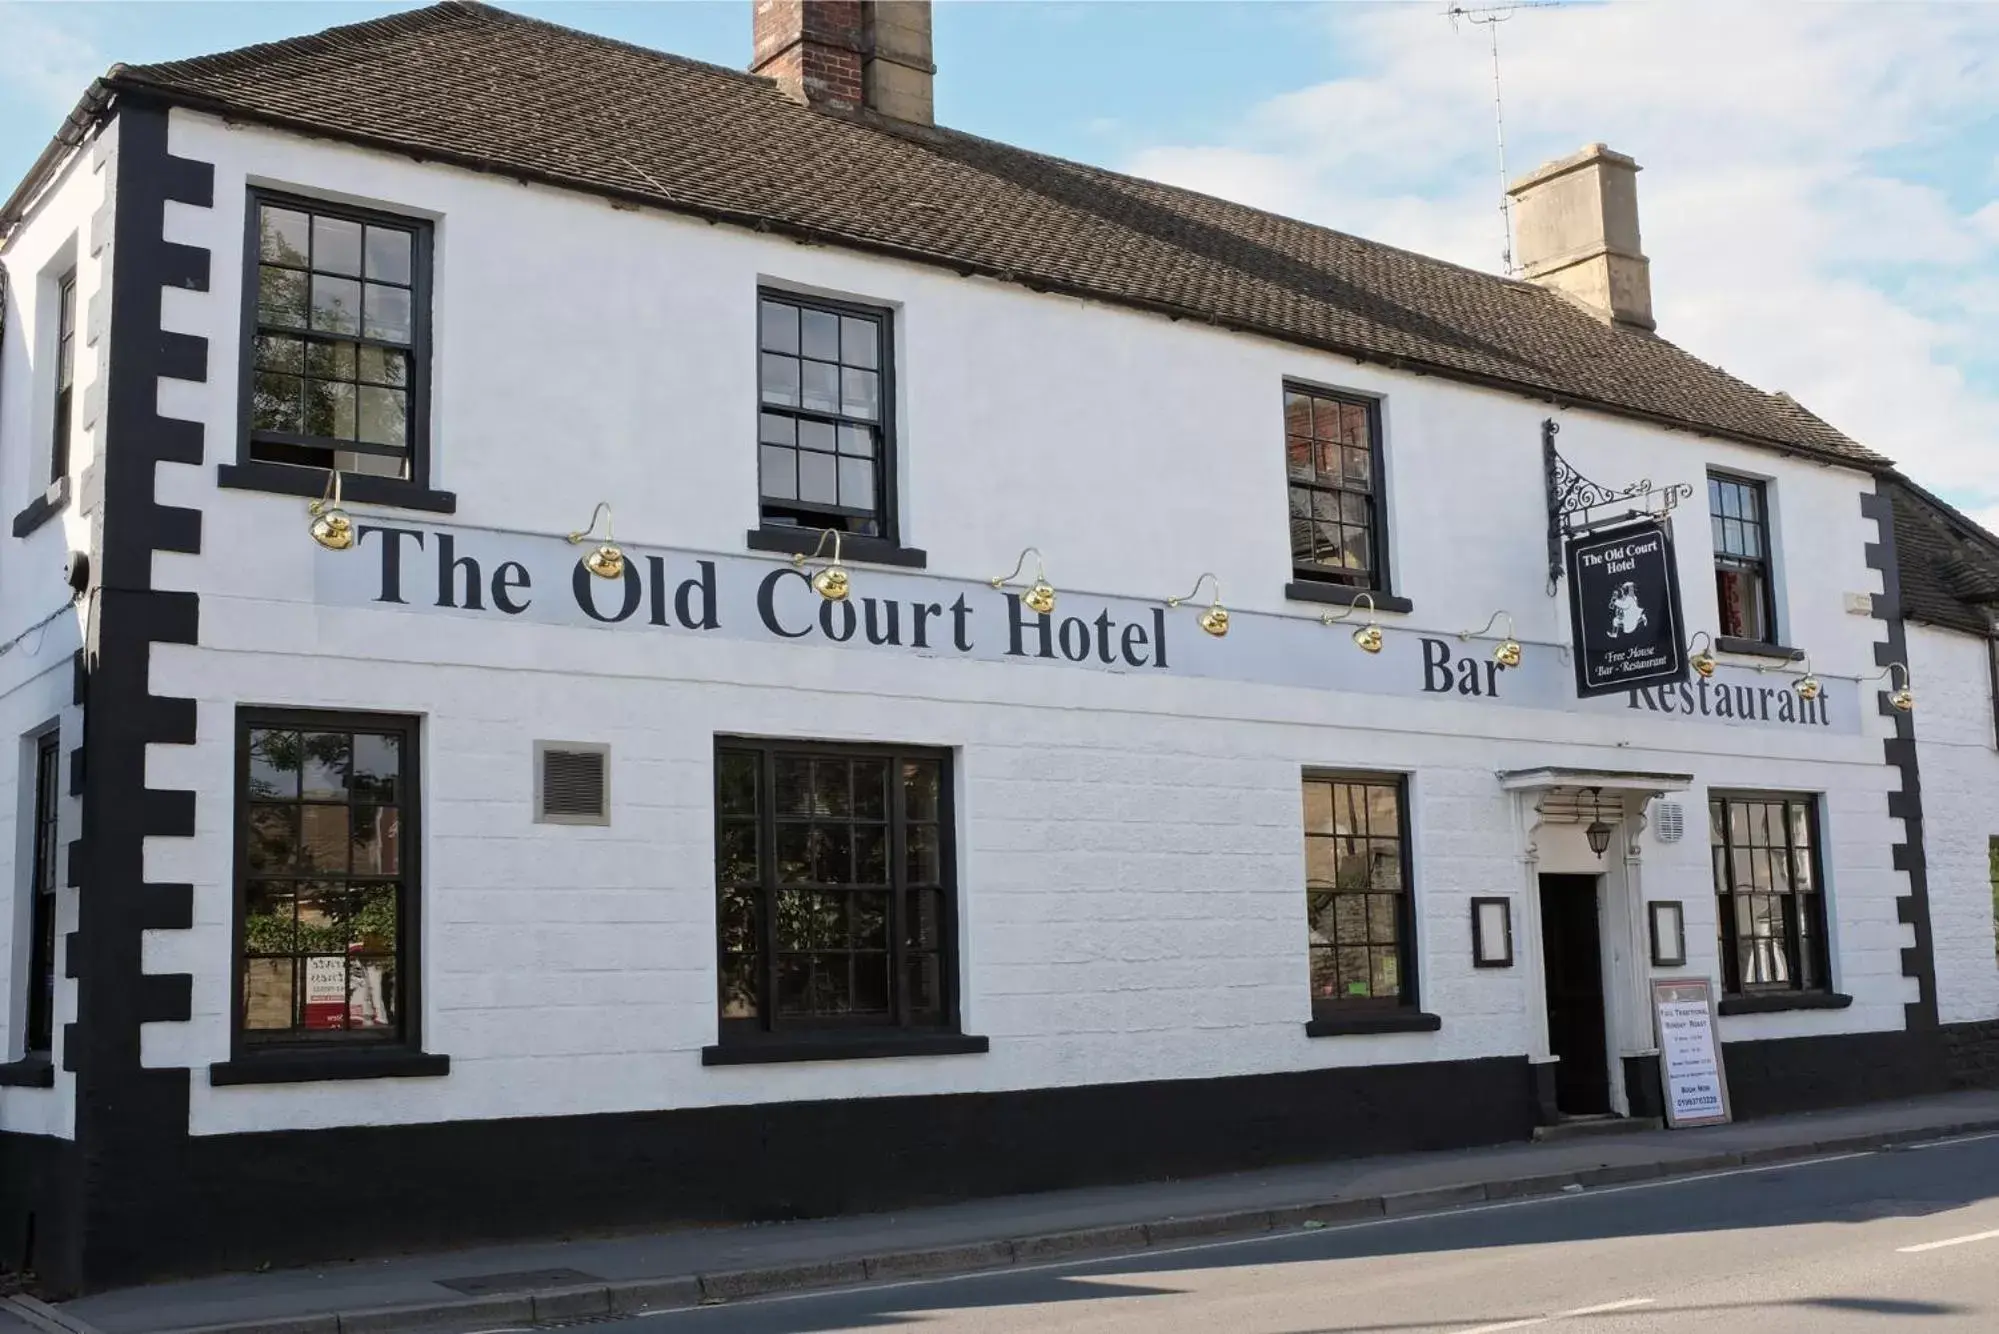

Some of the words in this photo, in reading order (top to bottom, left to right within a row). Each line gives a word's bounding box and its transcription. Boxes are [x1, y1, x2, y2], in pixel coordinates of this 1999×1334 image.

[1582, 554, 1603, 567] The
[1604, 547, 1625, 562] Old
[1626, 540, 1658, 557] Court
[1607, 557, 1636, 575] Hotel
[357, 524, 532, 615] The
[571, 554, 723, 630] Old
[757, 568, 975, 653] Court
[1003, 593, 1169, 669] Hotel
[1594, 665, 1613, 676] Bar
[1620, 655, 1667, 672] Restaurant
[1604, 651, 1626, 663] Free
[1626, 645, 1655, 659] House
[1420, 638, 1507, 699] Bar
